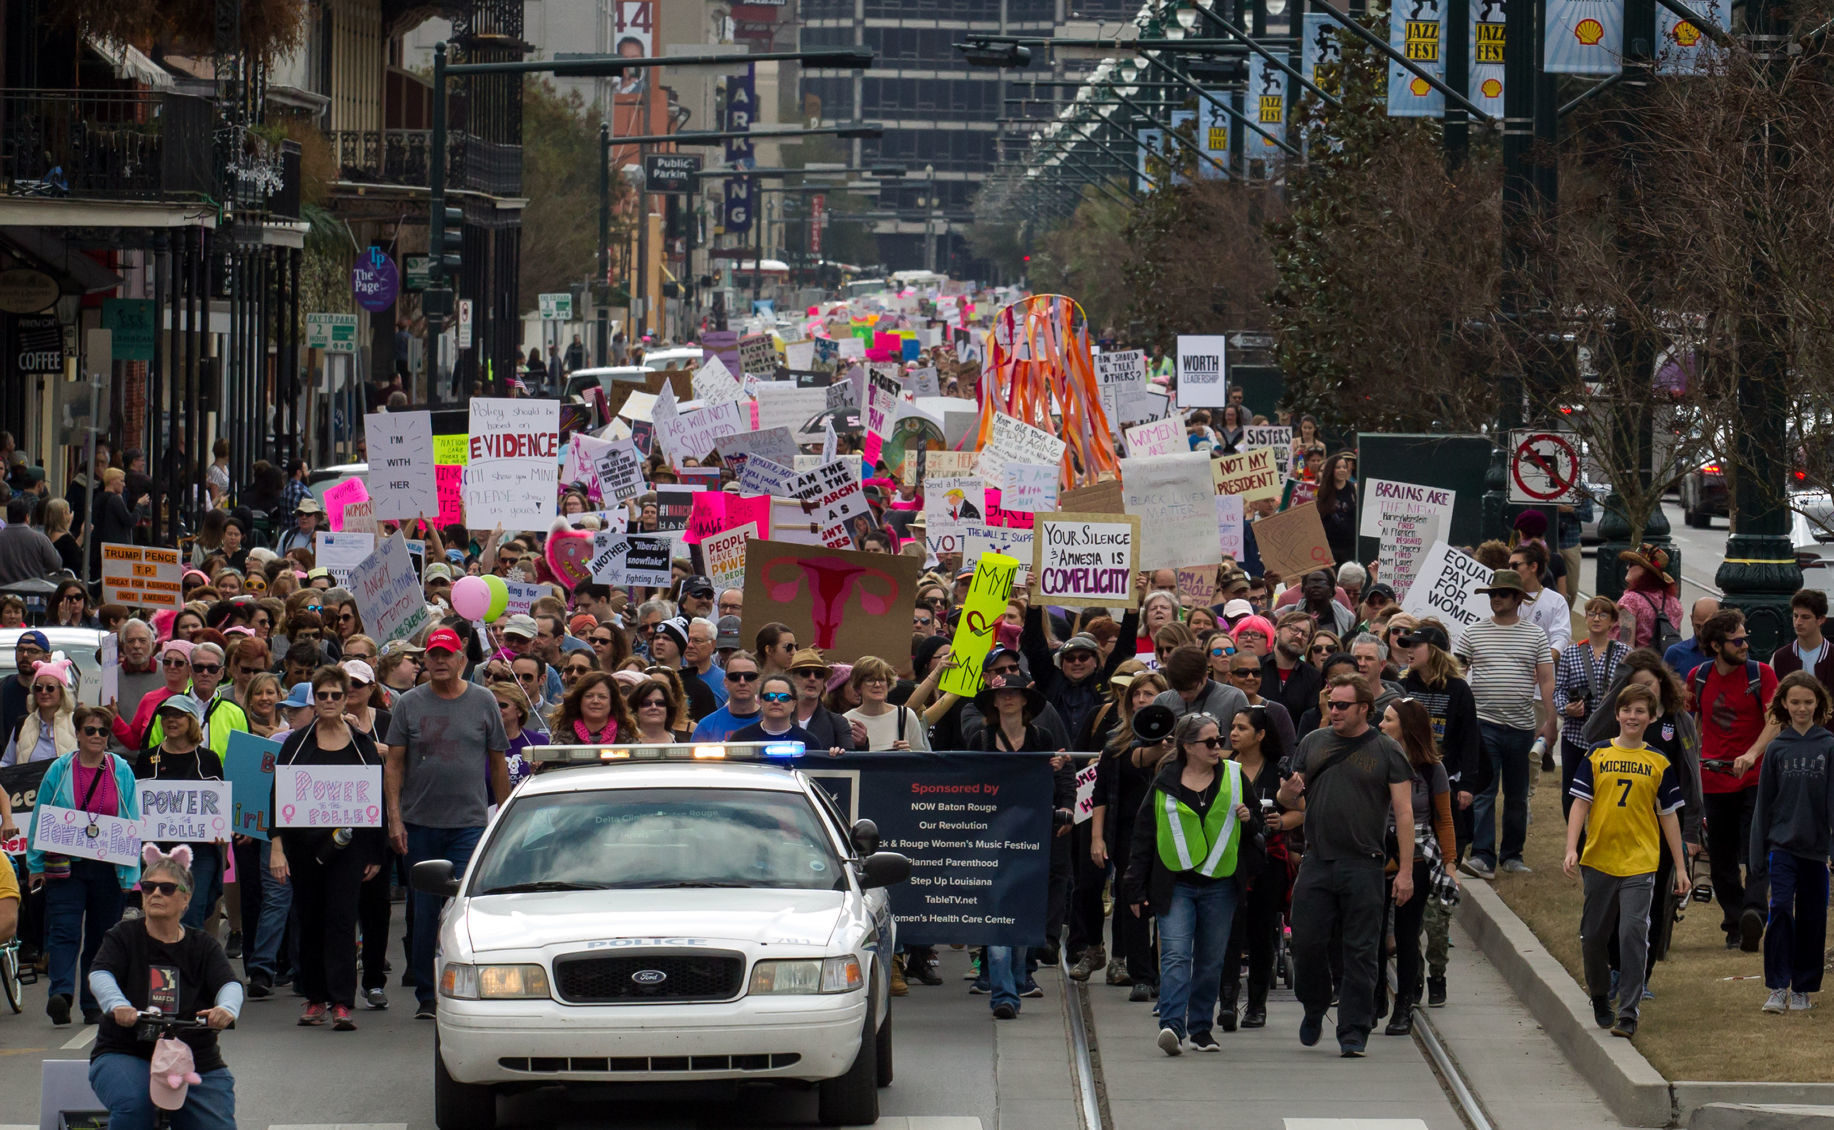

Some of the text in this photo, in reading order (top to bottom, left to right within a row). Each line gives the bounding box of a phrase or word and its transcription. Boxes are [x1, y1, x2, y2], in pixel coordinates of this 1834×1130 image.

[1406, 22, 1438, 41] JAZZ
[1406, 43, 1437, 61] FEST
[1260, 97, 1282, 107] JAZZ
[1260, 110, 1281, 122] FEST
[658, 158, 689, 168] Public
[653, 169, 687, 180] Parkin
[354, 269, 374, 281] The
[355, 281, 380, 295] Page
[308, 315, 323, 323] PAY
[324, 315, 333, 323] TO
[334, 316, 355, 324] PARK
[316, 325, 322, 334] 2
[19, 351, 61, 370] COFFEE
[1115, 352, 1139, 363] SHOULD
[1183, 355, 1220, 371] WORTH
[1113, 361, 1136, 372] TREAT
[1104, 371, 1142, 383] OTHERS?
[1184, 374, 1220, 384] LEADERSHIP
[471, 402, 555, 421] Policy should be
[486, 420, 531, 432] based on
[664, 403, 731, 438] We NOT
[390, 435, 404, 444] I'M
[1129, 421, 1179, 448] WOMEN
[1247, 428, 1291, 446] SISTERS
[470, 433, 558, 460] EVIDENCE
[1028, 438, 1060, 457] AGING
[387, 458, 410, 468] WITH
[610, 459, 620, 467] SEE
[620, 456, 631, 464] YOU
[1219, 457, 1244, 476] NOT
[1248, 452, 1268, 472] MY
[600, 461, 638, 477] TRUMP AND WE
[491, 472, 514, 482] show
[516, 473, 528, 484] you
[605, 469, 635, 483] KNOW WHAT
[786, 483, 794, 492] I
[798, 471, 818, 486] AM
[821, 460, 847, 479] THE
[825, 472, 853, 491] THE
[390, 481, 409, 490] HER
[925, 480, 944, 489] Send
[953, 478, 982, 491] Message
[1217, 471, 1275, 496] PRESIDENT
[469, 489, 511, 508] PLEASE
[522, 493, 546, 504] show
[1130, 491, 1207, 507] BLACK LIVES
[1375, 481, 1450, 506] BRAINS ARE
[490, 507, 500, 515] us
[1146, 503, 1197, 519] MATTER
[1396, 521, 1415, 530] FIRED
[967, 528, 1007, 542] THE WALL I
[1044, 522, 1131, 547] YOUR SILENCE
[1382, 527, 1416, 538] Al Franken
[709, 531, 750, 557] PEOPLE
[1395, 537, 1423, 545] RESIGNED
[1380, 543, 1421, 554] Kevin Spacey
[145, 552, 178, 564] PENCE
[592, 541, 630, 576] ANOTHER
[627, 557, 667, 567] snowflake"
[710, 549, 734, 567] HAVE
[1059, 548, 1124, 567] AMNESIA IS
[1379, 558, 1414, 567] Matt Lauer
[1443, 549, 1494, 586] EQUAL
[106, 577, 129, 586] GREAT
[364, 561, 391, 598] ANGRY
[625, 573, 670, 585] fighting for...
[1041, 567, 1131, 596] COMPLICITY
[1378, 571, 1393, 580] John
[1441, 564, 1471, 589] PAY
[526, 587, 537, 597] for
[1434, 577, 1467, 606] FOR
[1427, 589, 1480, 626] WOME
[1599, 760, 1653, 778] MICHIGAN
[295, 770, 370, 803] POWER
[911, 783, 999, 795] Sponsored by
[1617, 779, 1634, 807] 7
[142, 789, 222, 816] POWER
[911, 802, 997, 813] NOW Baton Rouge
[309, 808, 364, 825] POLLS
[595, 815, 620, 824] Delta
[689, 809, 719, 818] Rouge
[40, 812, 100, 851] POWER
[158, 823, 206, 839] POLLS
[919, 821, 988, 830] Our Revolution
[890, 840, 1039, 850] & Rouge Women's Music Festival
[945, 858, 998, 868] Parenthood
[910, 876, 992, 887] Step Up Louisiana
[924, 895, 977, 904] TableTV.net
[891, 913, 1015, 924] omen's Health Care Center
[587, 938, 707, 949] POLICE
[640, 971, 658, 982] Ford
[152, 994, 175, 1003] MARCH
